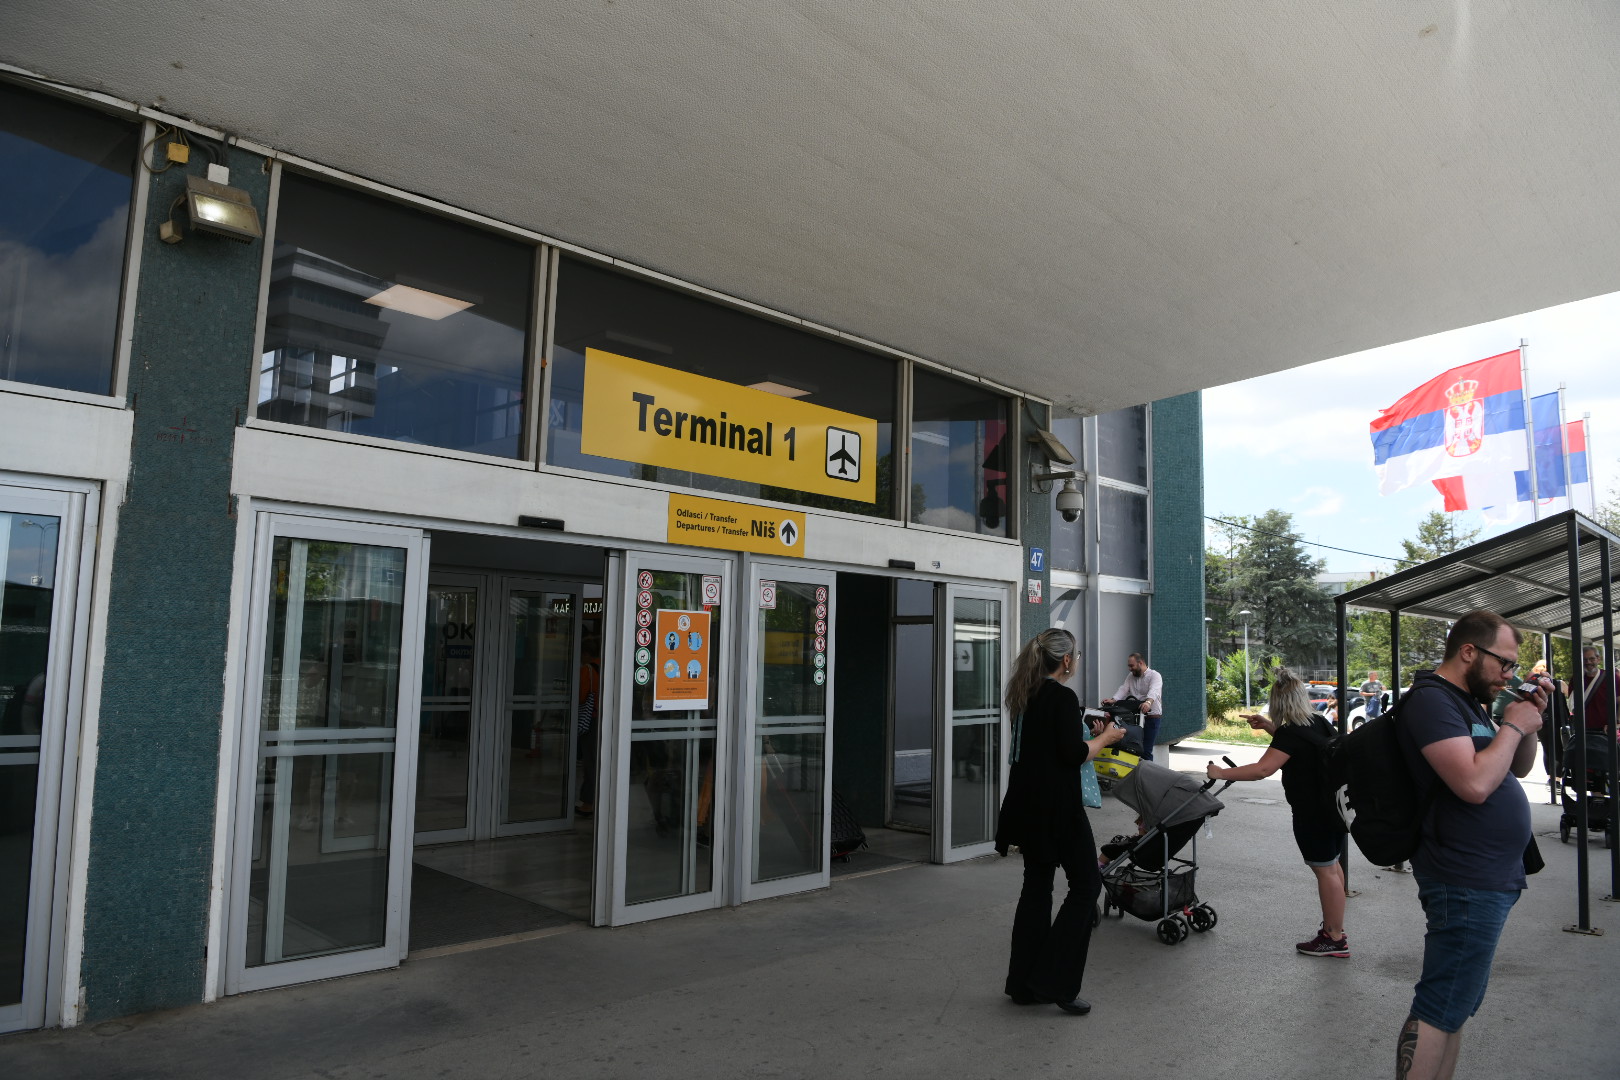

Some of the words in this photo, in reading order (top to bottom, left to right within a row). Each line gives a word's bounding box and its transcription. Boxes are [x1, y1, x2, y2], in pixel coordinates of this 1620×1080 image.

[632, 391, 773, 457] Terminal
[784, 426, 796, 461] 1
[676, 508, 703, 519] Odlasci
[710, 512, 738, 524] Transfer
[676, 520, 715, 533] Departures
[716, 526, 721, 534] /
[722, 526, 749, 537] Transfer
[751, 520, 775, 539] Niš
[1031, 552, 1043, 567] 47
